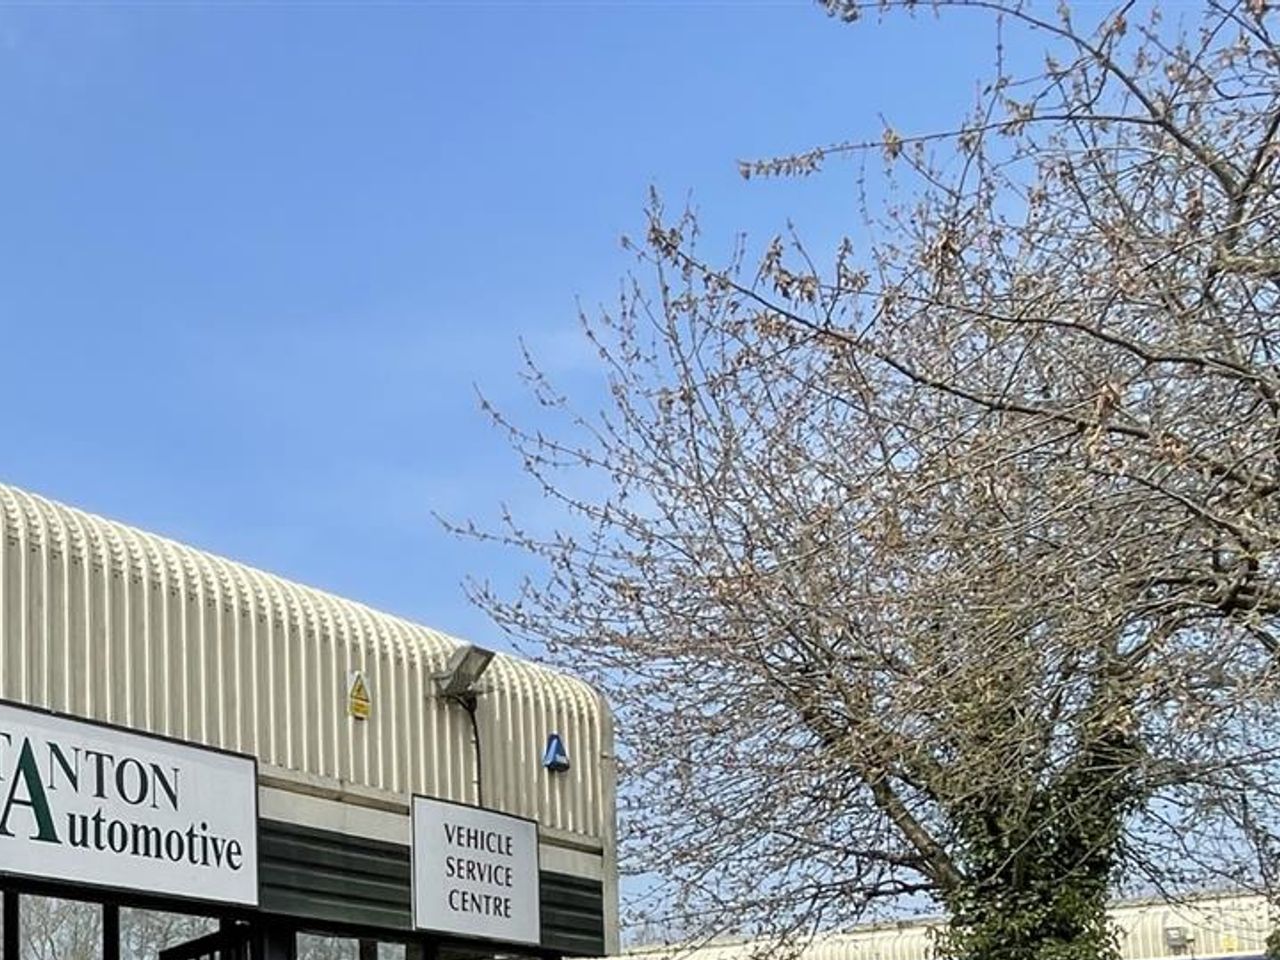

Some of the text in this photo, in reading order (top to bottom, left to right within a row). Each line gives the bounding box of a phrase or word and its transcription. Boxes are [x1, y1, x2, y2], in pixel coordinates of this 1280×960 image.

[444, 822, 513, 857] VEHICLE
[446, 856, 513, 888] SERVICE
[448, 888, 512, 919] CENTRE
